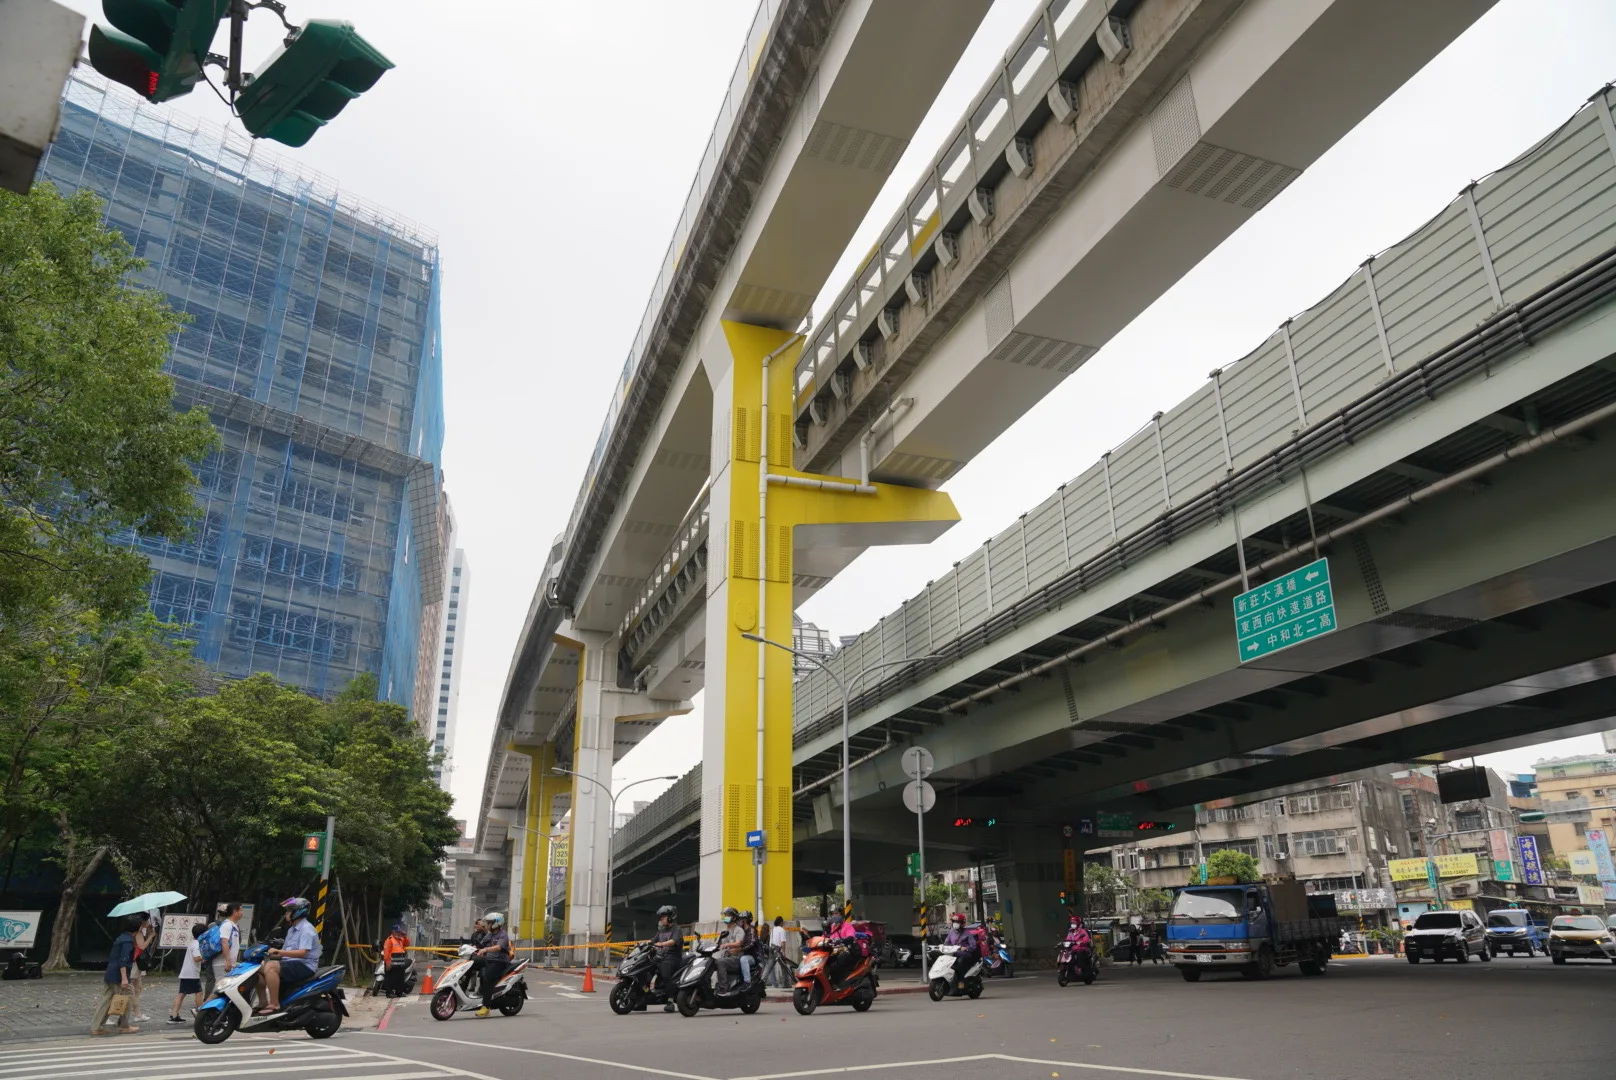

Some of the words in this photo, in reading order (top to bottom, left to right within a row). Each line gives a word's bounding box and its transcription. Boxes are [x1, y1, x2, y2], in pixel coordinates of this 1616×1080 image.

[1241, 590, 1327, 635] 東西向快速道路
[1267, 613, 1332, 647] 中和北二高
